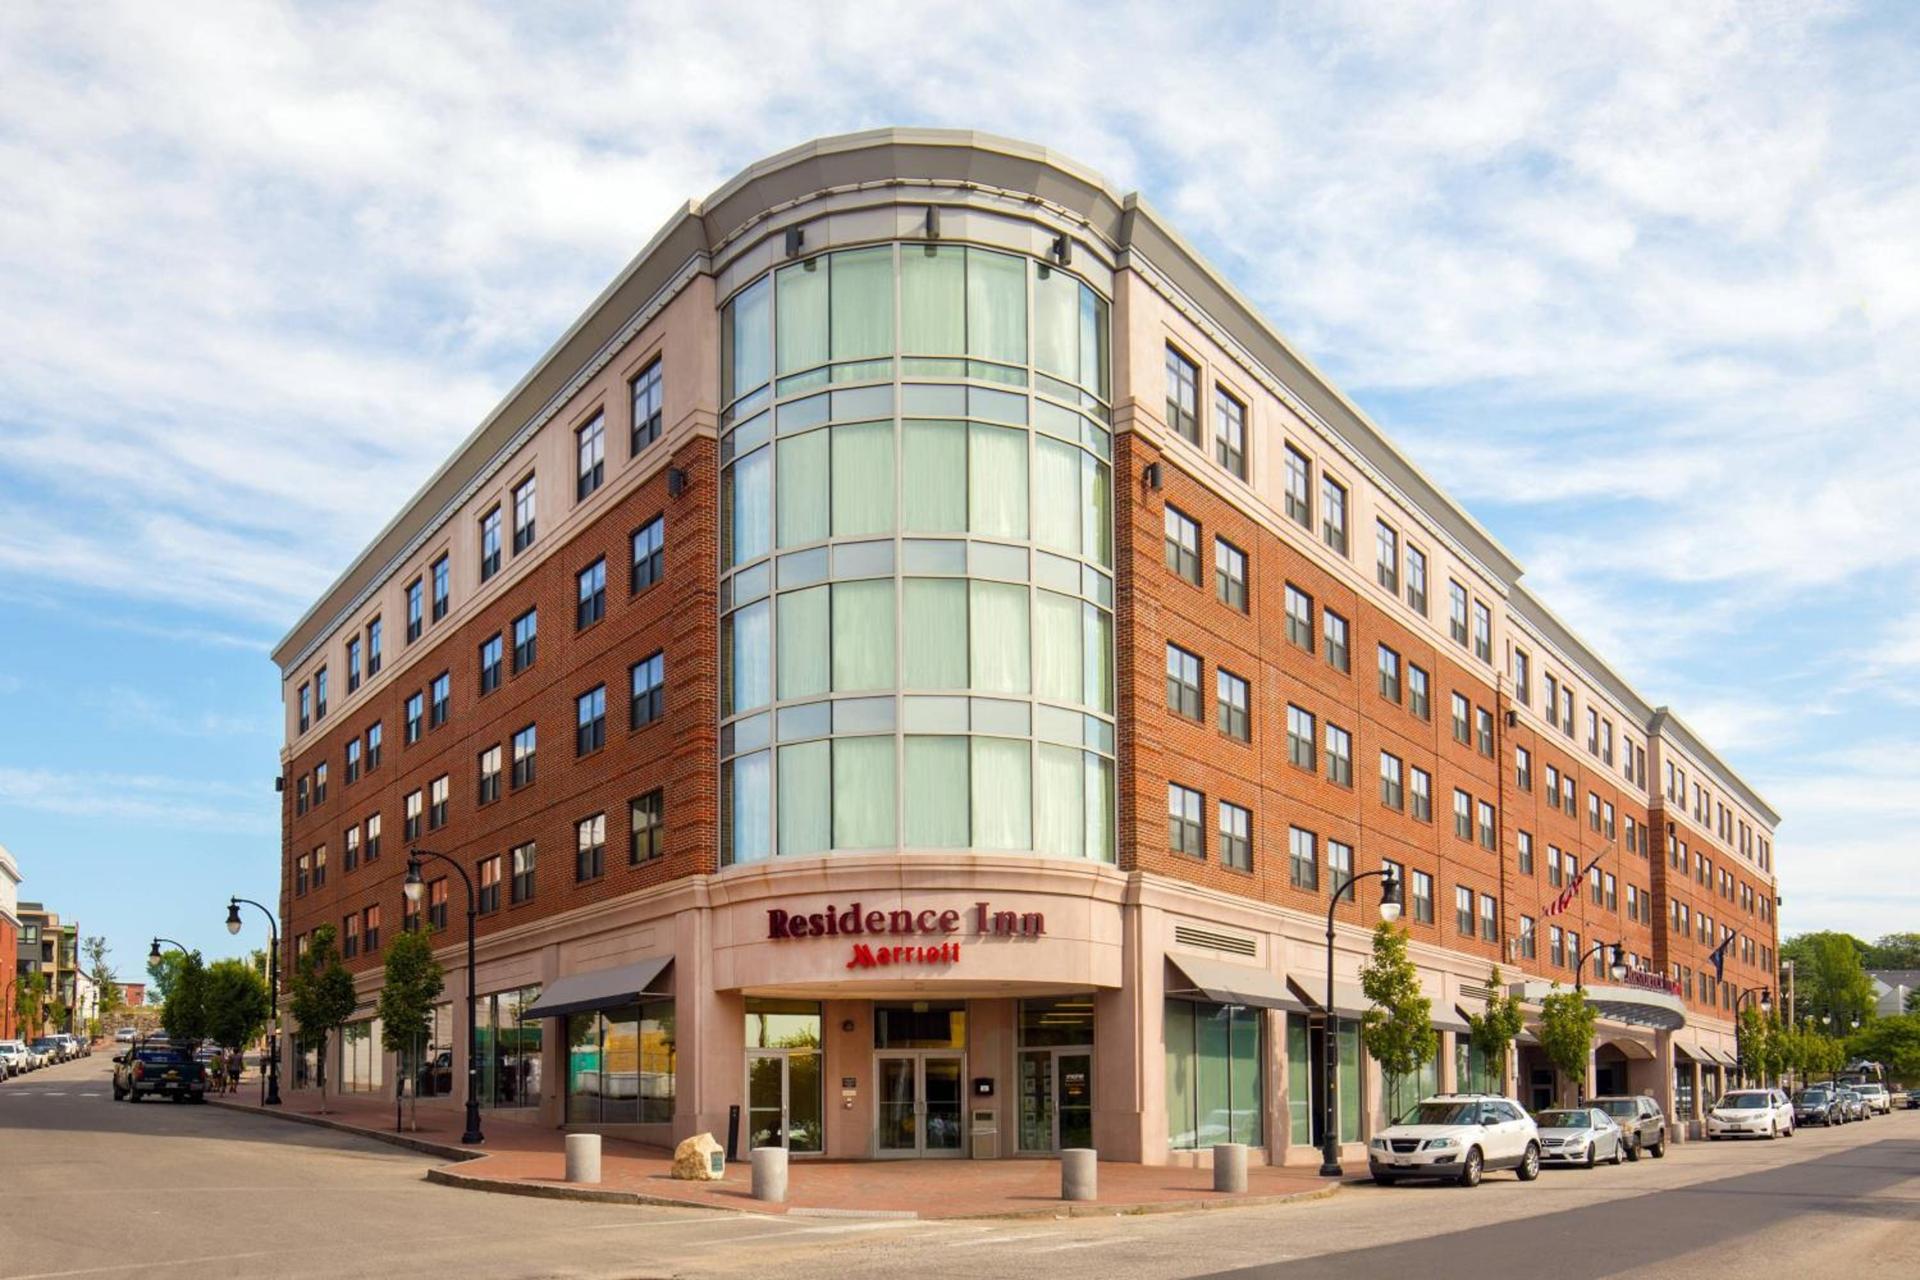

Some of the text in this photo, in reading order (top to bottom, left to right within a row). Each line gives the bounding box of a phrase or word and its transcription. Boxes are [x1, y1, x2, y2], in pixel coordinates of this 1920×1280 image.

[767, 902, 1047, 939] Residence Inn
[846, 942, 960, 969] Marriott
